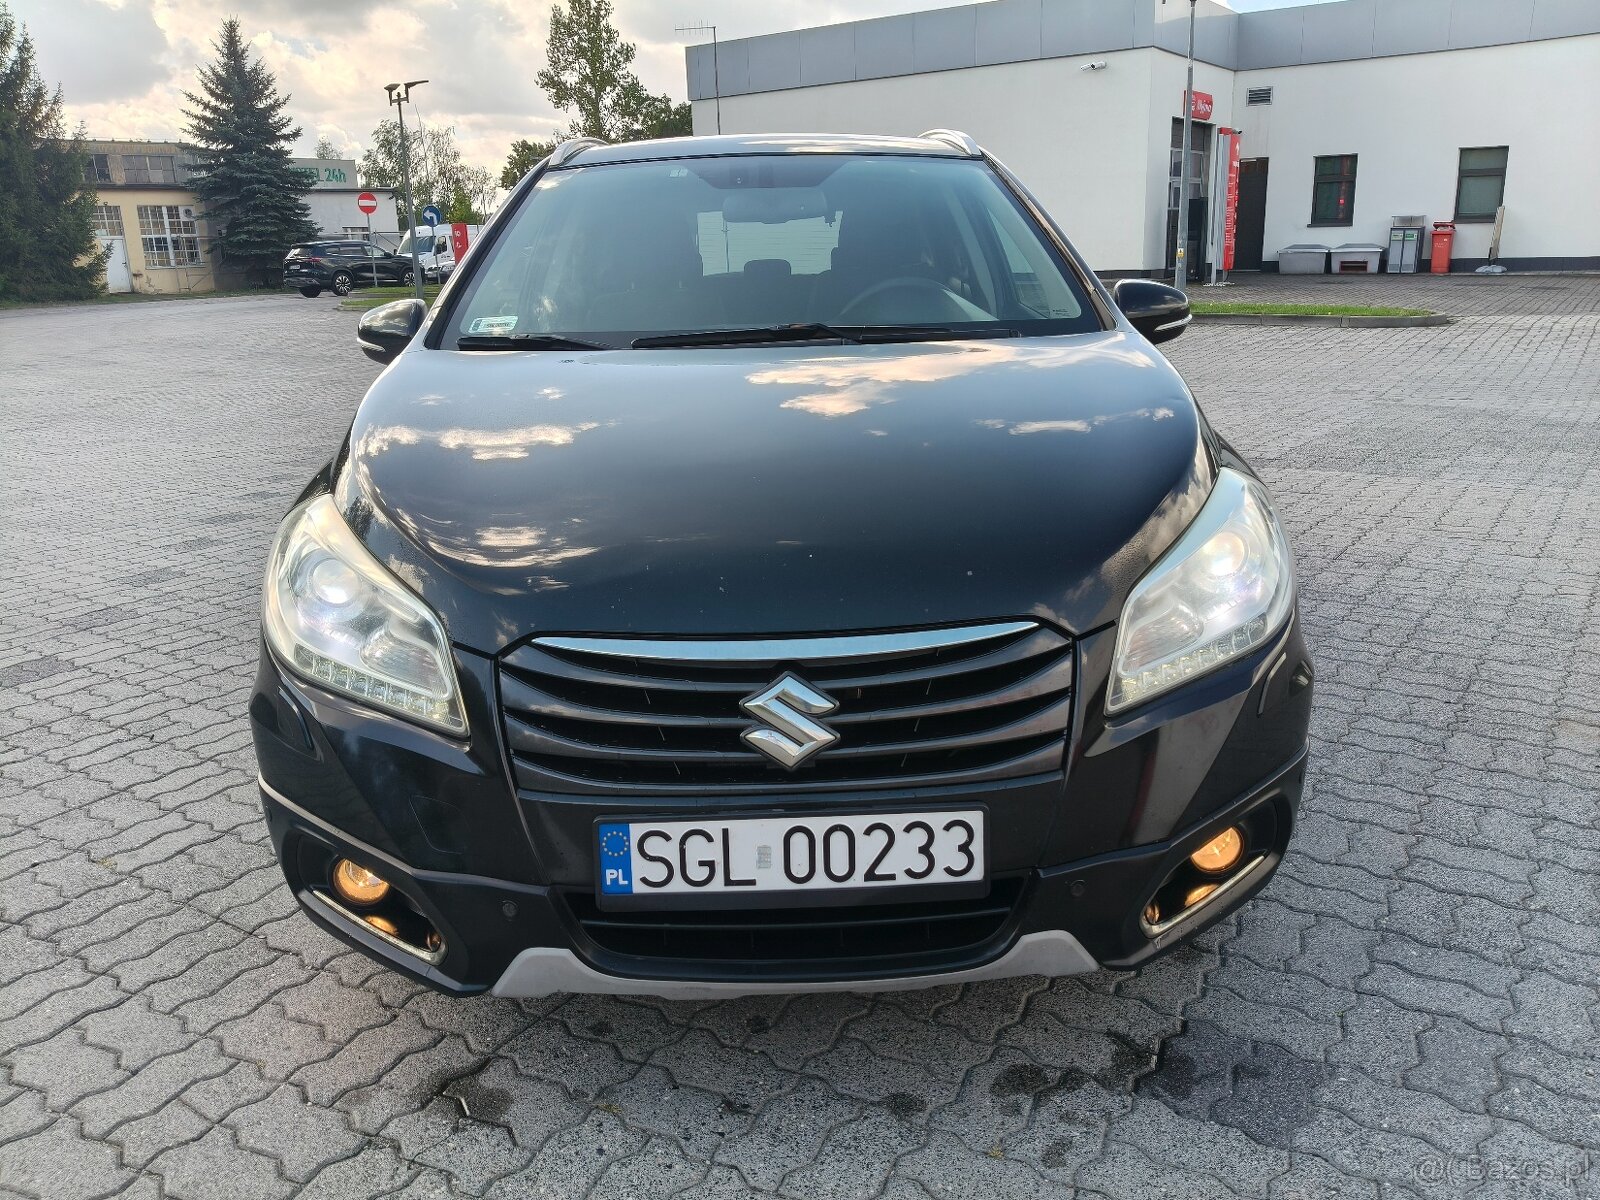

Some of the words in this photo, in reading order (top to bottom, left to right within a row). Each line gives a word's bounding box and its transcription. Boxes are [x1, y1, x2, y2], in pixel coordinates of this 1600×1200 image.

[325, 167, 346, 182] 24h
[636, 827, 757, 889] SGL
[782, 818, 975, 885] 00233
[605, 868, 629, 886] PL
